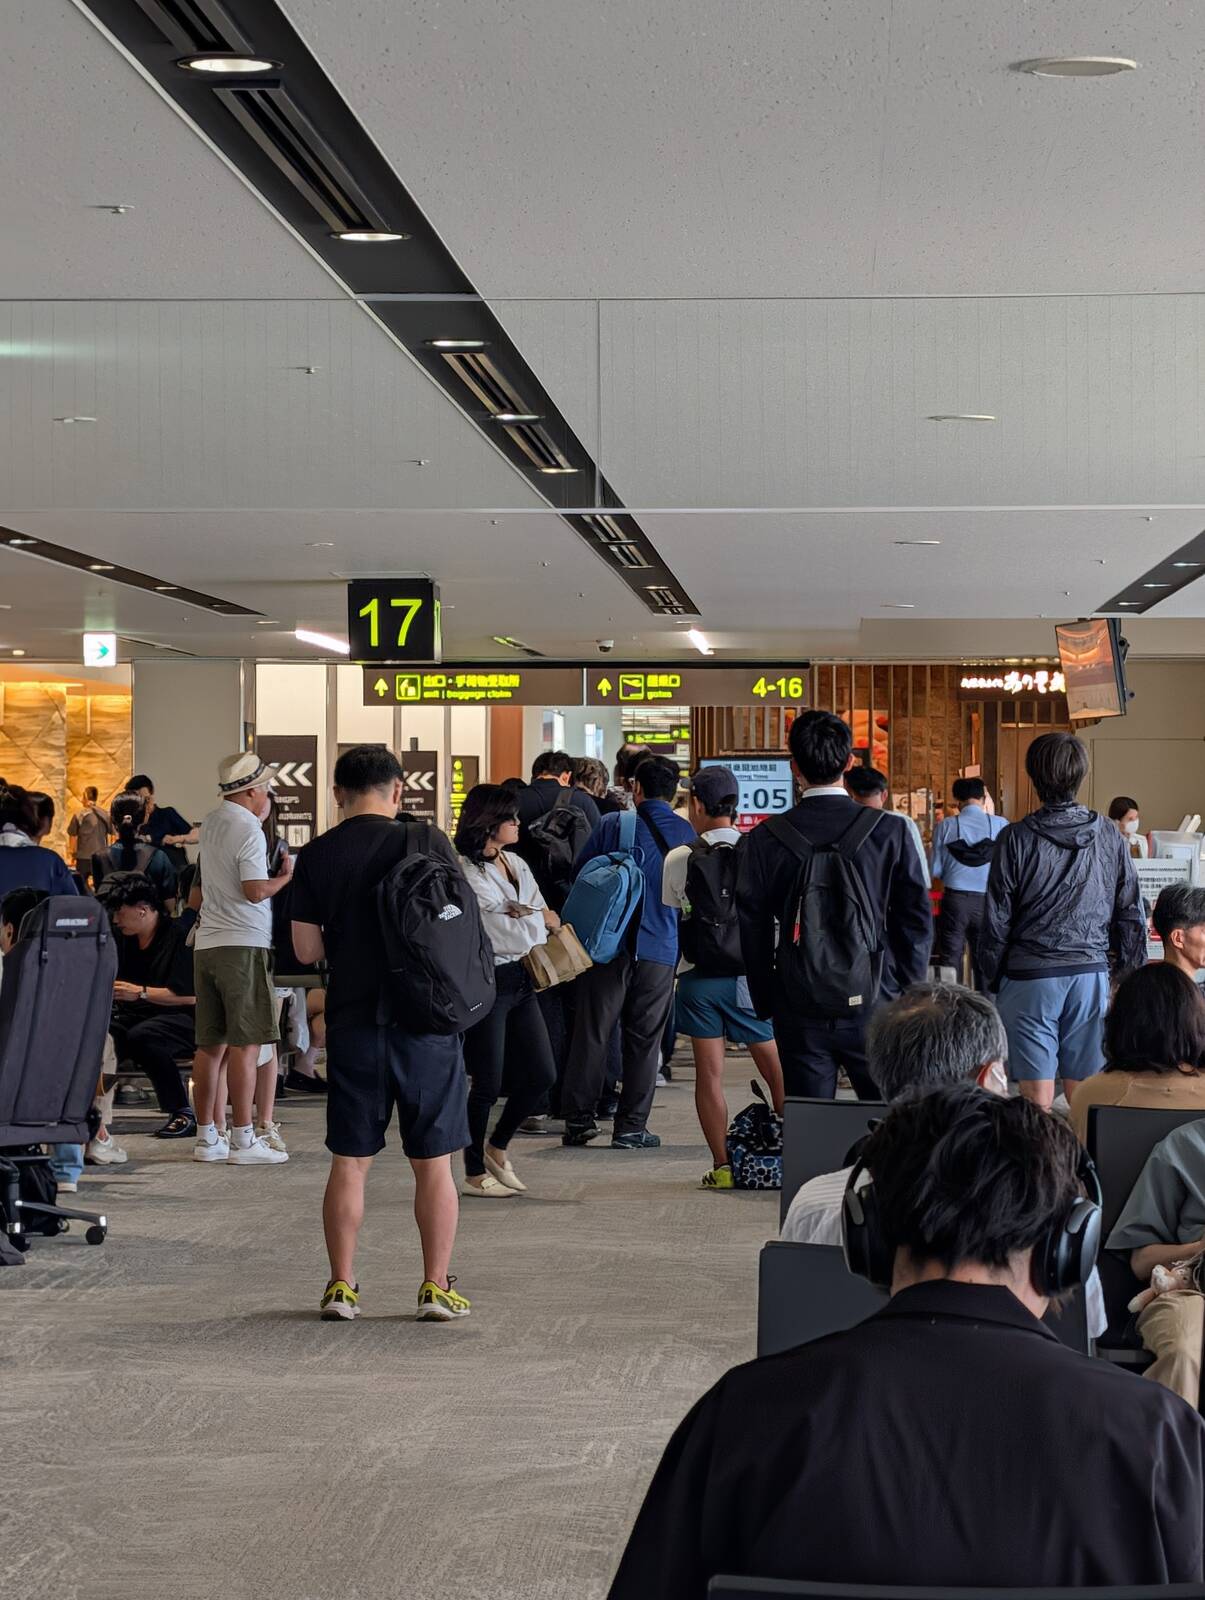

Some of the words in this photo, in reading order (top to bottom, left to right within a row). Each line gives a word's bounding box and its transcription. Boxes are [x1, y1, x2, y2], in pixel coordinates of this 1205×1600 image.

[359, 598, 422, 647] 17
[752, 677, 803, 698] 4-16
[743, 788, 787, 809] :05
